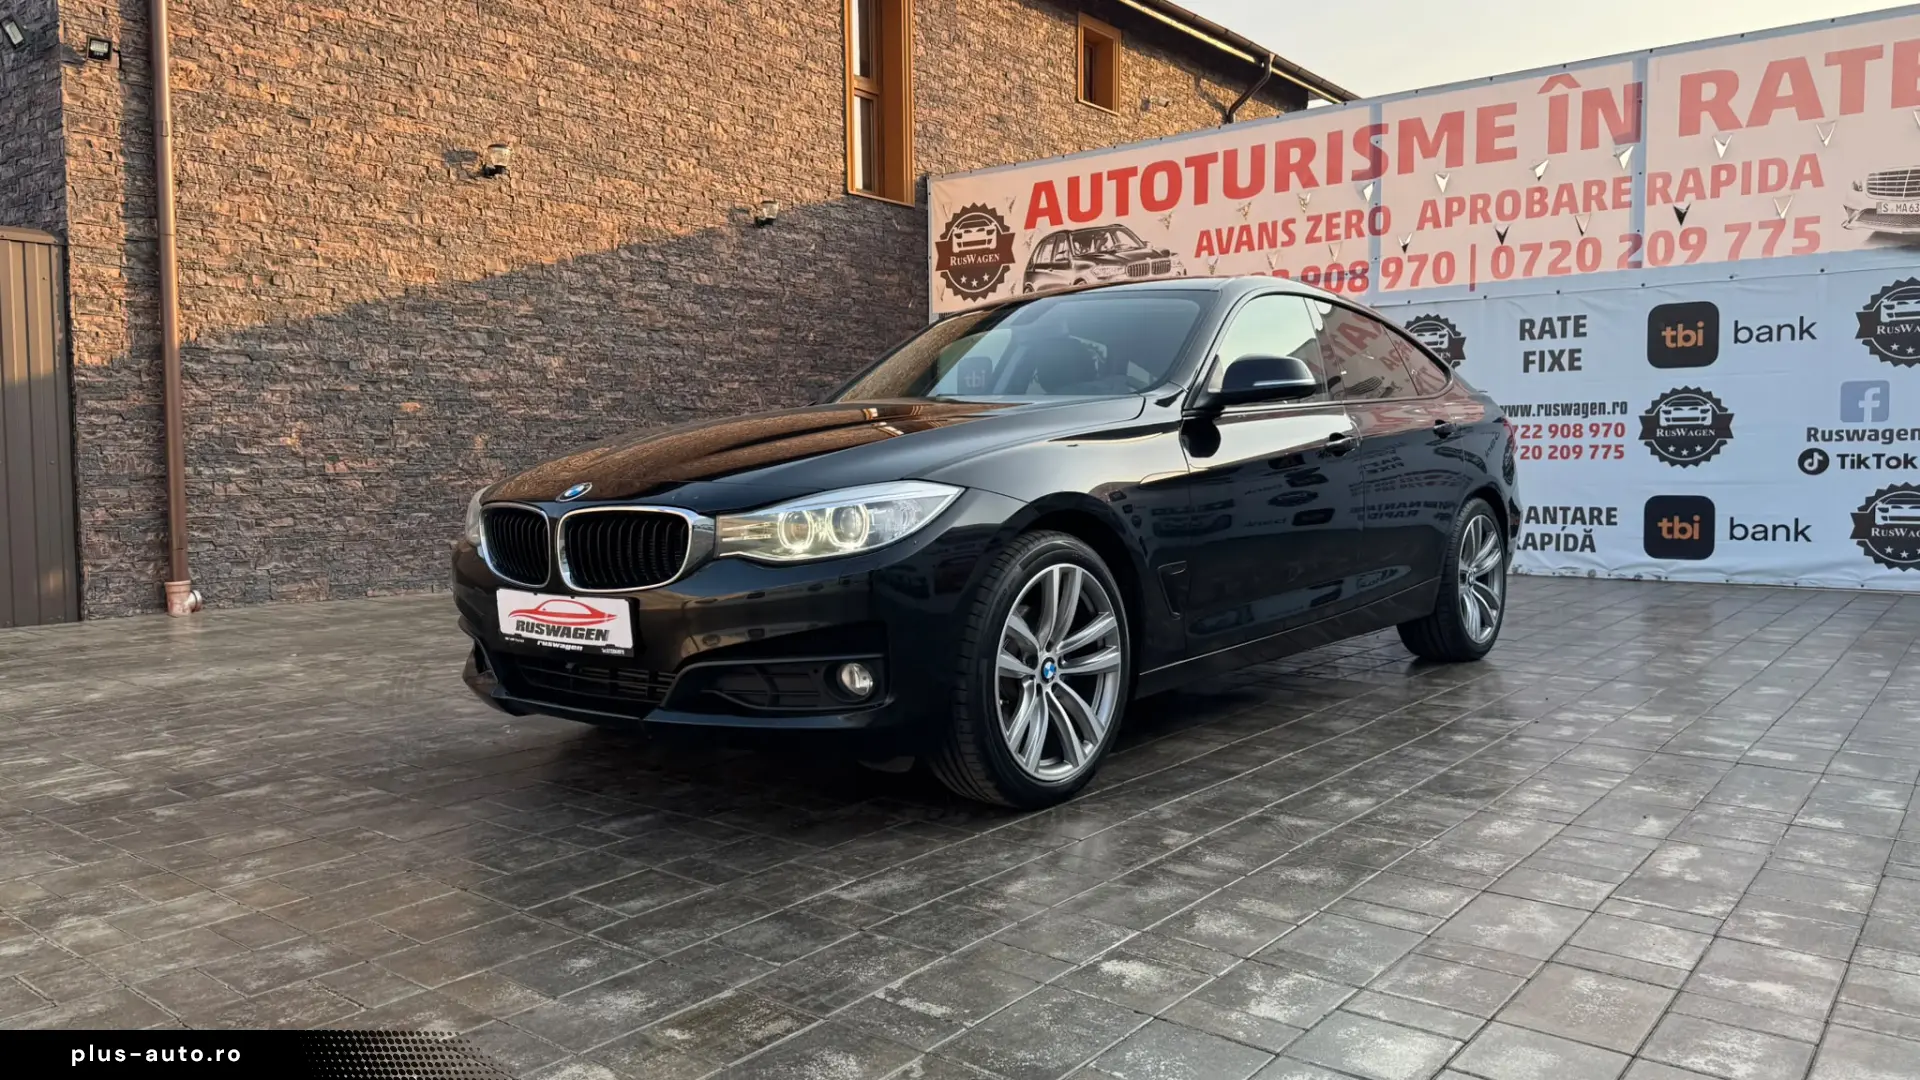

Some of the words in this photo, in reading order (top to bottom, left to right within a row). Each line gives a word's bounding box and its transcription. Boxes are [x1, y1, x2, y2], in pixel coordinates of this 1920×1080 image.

[1024, 103, 1517, 229] AUTOTURISME
[1537, 73, 1643, 155] ÎN
[1194, 217, 1297, 258] AVANS
[1305, 205, 1391, 244] ZERO
[1416, 176, 1633, 232] APROBARE
[1646, 153, 1825, 207] RAPIDA
[1380, 250, 1456, 290] 970
[1490, 236, 1602, 281] 0720
[1617, 226, 1708, 270] 209
[1724, 215, 1821, 259] 775
[1519, 314, 1588, 341] RATE
[1661, 320, 1704, 349] tbi
[1733, 316, 1817, 344] bank
[1522, 348, 1582, 374] FIXE
[1548, 423, 1584, 439] 908
[1589, 422, 1626, 438] 970
[1515, 444, 1543, 460] 20
[1547, 444, 1584, 460] 209
[1588, 444, 1625, 460] 775
[1836, 453, 1918, 470] TikTok
[1516, 528, 1597, 553] APIDĂ
[1657, 514, 1700, 541] tbi
[1729, 517, 1812, 542] bank
[515, 619, 610, 642] RUSWAGEN
[537, 640, 583, 651] ruswagen
